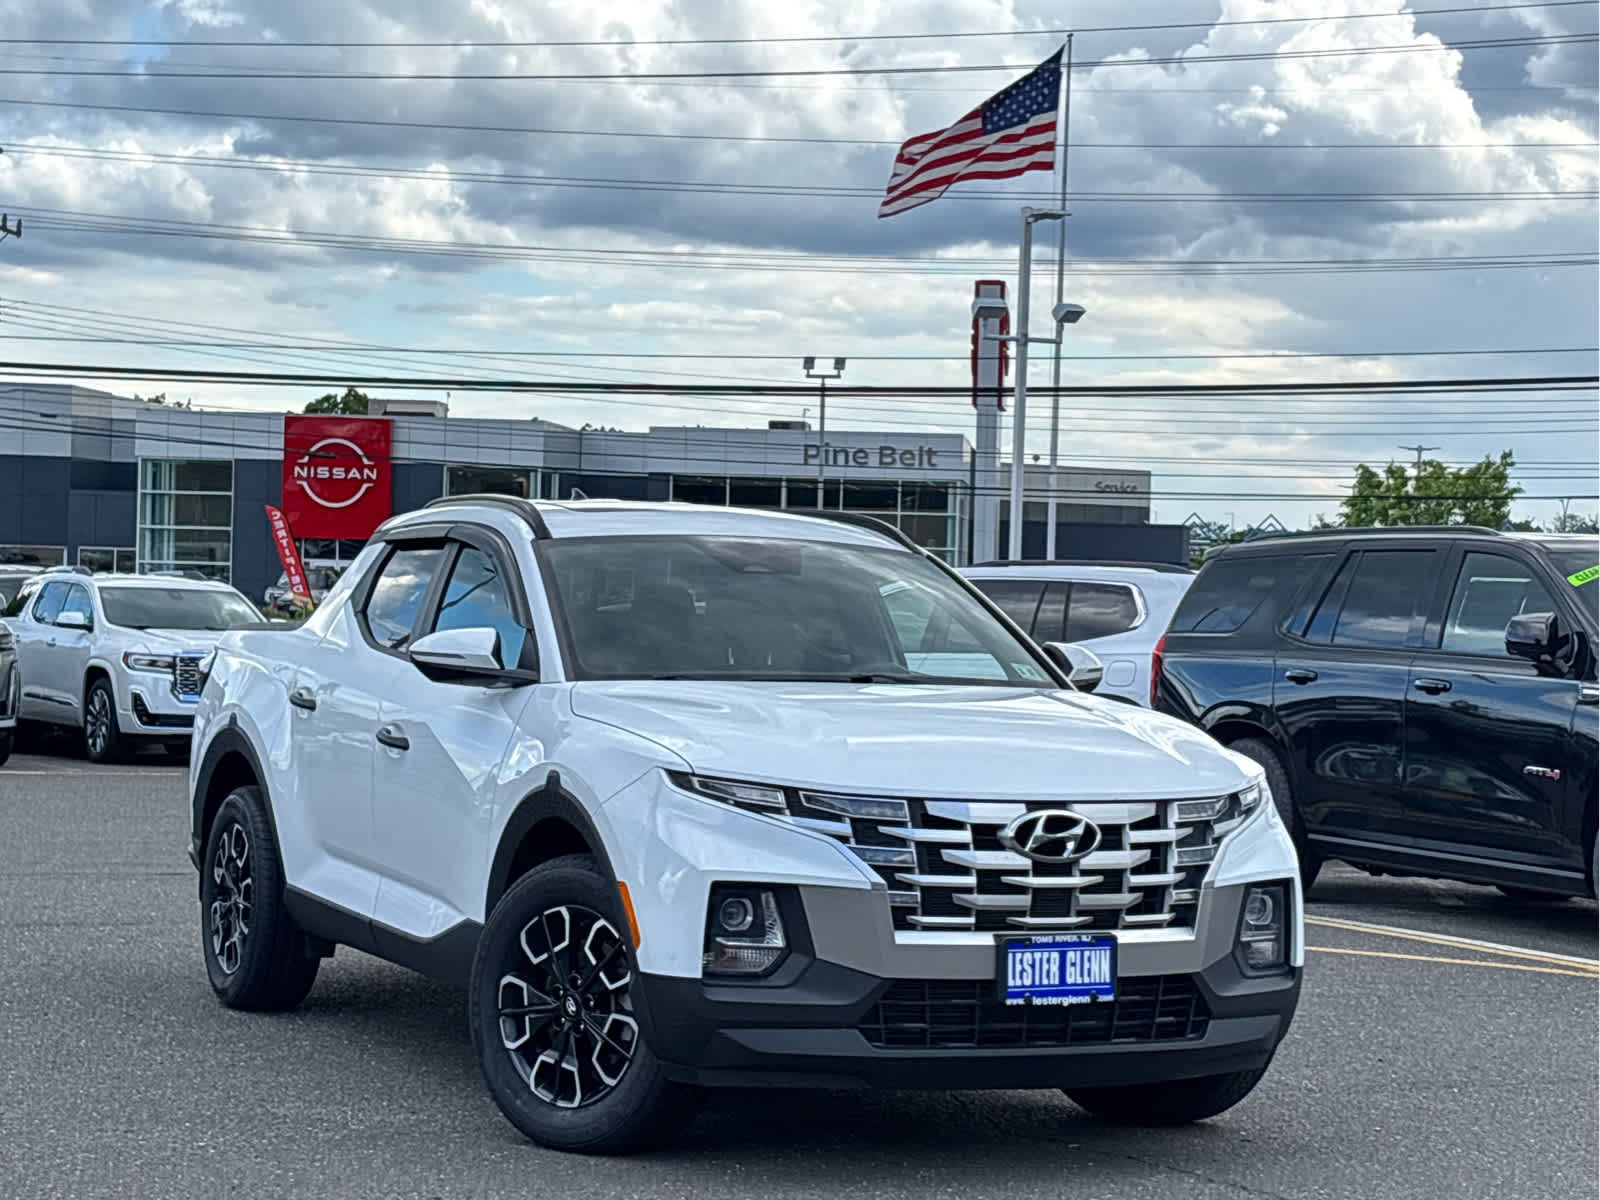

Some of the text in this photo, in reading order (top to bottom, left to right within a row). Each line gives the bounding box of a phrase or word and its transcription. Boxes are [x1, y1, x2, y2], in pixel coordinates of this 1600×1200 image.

[803, 442, 937, 467] Pine Belt
[293, 465, 377, 480] NISSAN
[1094, 480, 1138, 492] Service
[1007, 949, 1111, 987] LESTER GLENN
